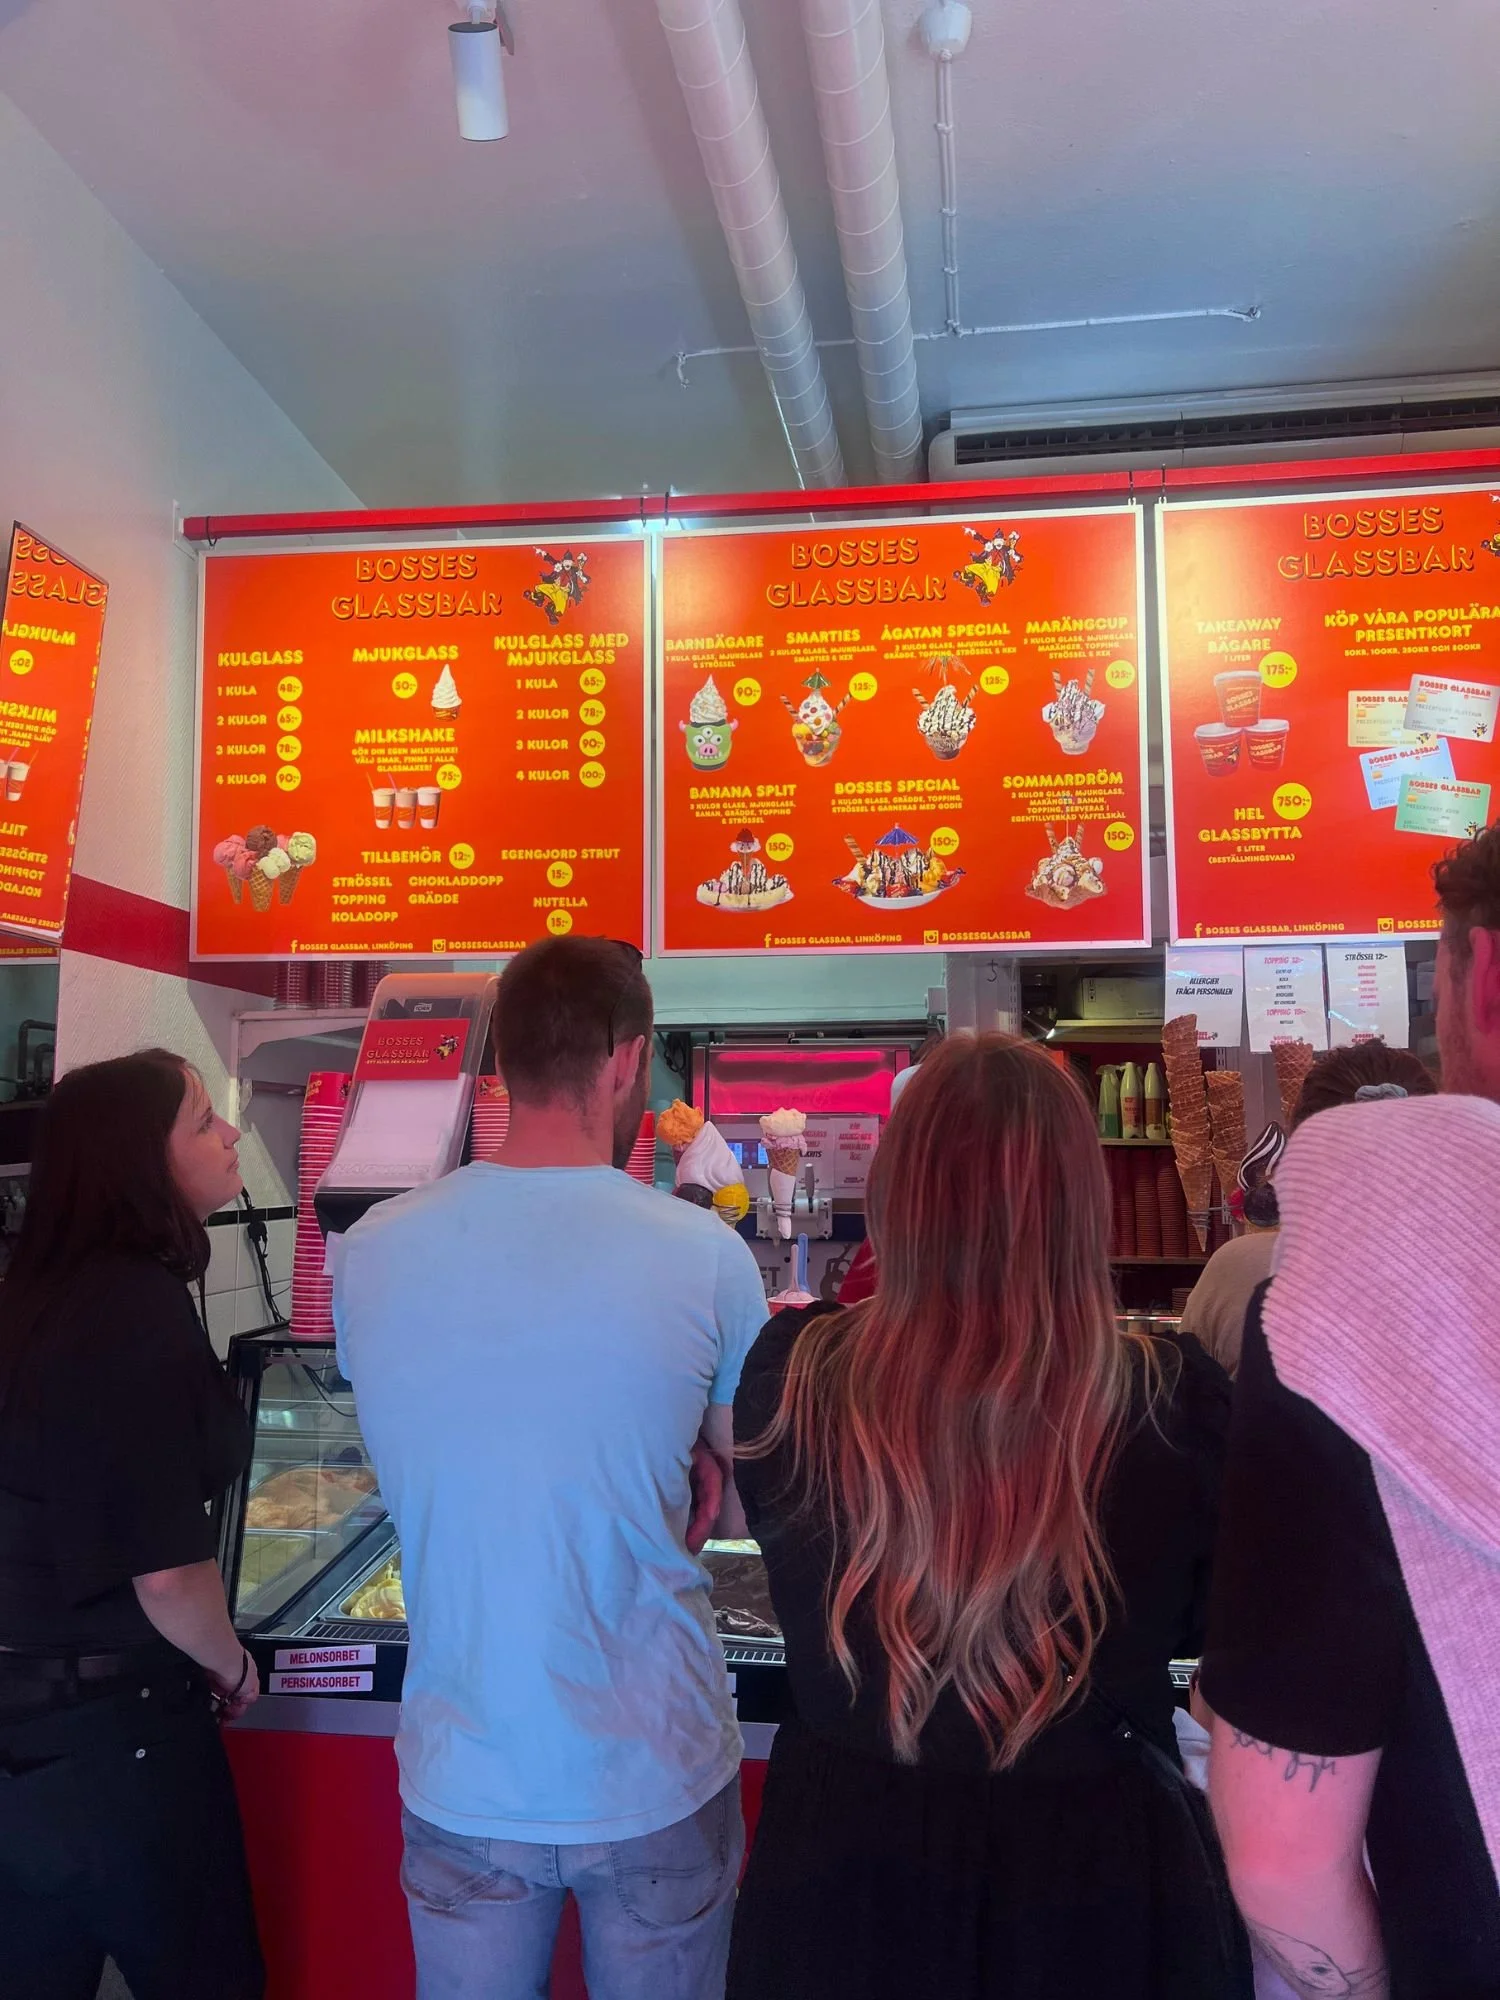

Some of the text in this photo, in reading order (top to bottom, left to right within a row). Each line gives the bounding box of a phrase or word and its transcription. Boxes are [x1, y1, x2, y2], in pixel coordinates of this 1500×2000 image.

[1303, 506, 1444, 539] BOSSES
[790, 537, 919, 569] BOSSES
[356, 553, 478, 582] BOSSES
[1277, 544, 1475, 580] GLASSBAR
[765, 575, 946, 608] GLASSBAR
[331, 589, 502, 621] GLASSBAR
[1324, 602, 1500, 627] KÖP VÅRA POPULÄRA
[880, 622, 1011, 640] ÅGATAN SPECIAL
[1026, 615, 1129, 634] MARÄNGCUP
[1196, 617, 1282, 633] TAKEAWAY
[786, 629, 861, 645] SMARTIES
[1355, 624, 1473, 642] PRESENTKORT
[494, 633, 630, 650] KULGLASS MED
[665, 633, 764, 651] BARNBÄGARE
[1207, 636, 1272, 654] BÄGARE
[218, 650, 304, 667] KULGLASS
[352, 645, 460, 663] MJUKGLASS
[506, 650, 616, 666] MJUKGLASS
[217, 685, 257, 696] 1 KULA
[517, 678, 558, 689] 1 KULA
[1418, 679, 1492, 697] BOSSES GLASSBAR
[1356, 695, 1385, 703] BOSSES
[216, 714, 267, 725] 2 KULOR
[516, 708, 569, 720] 2 KULOR
[354, 728, 456, 744] MILKSHAKE
[216, 743, 266, 755] 3 KULOR
[516, 739, 568, 750] 3 KULOR
[1368, 745, 1440, 765] BOSSES GLASSBAR
[216, 773, 267, 784] 4 KULOR
[516, 770, 570, 781] 4 KULOR
[1003, 768, 1124, 788] SOMMARDRÖM
[689, 784, 797, 799] BANANA SPLIT
[834, 778, 960, 795] BOSSES SPECIAL
[1408, 780, 1438, 790] BOSSES
[1439, 785, 1482, 796] GLASSBAR
[1234, 807, 1265, 821] HEL
[1198, 826, 1303, 842] GLASSBYTTA
[362, 845, 442, 865] TILLBEHÖR
[501, 848, 621, 860] EGENGJORD STRUT
[332, 873, 393, 888] STRÖSSEL
[408, 875, 504, 887] CHOKLADDOPP
[332, 893, 387, 906] TOPPING
[408, 890, 459, 904] GRÄDDE
[533, 897, 588, 907] NUTELLA
[332, 911, 399, 922] KOLADOPP
[1205, 926, 1241, 935] BOSSES
[1293, 921, 1345, 932] LINKÖPING
[774, 936, 808, 945] BOSSES
[855, 933, 902, 943] LINKÖPING
[941, 931, 1031, 941] BOSSESGLASSBAR
[300, 943, 328, 951] BOSSES
[371, 941, 413, 950] LINKÖPING
[449, 940, 526, 950] BOSSESGLASSBAR
[1344, 951, 1374, 960] STRÖSSEL
[1189, 977, 1219, 985] ALLERGIER
[1175, 986, 1233, 996] FRÅGA PERSONALEN
[377, 1036, 424, 1046] BOSSES
[366, 1049, 429, 1059] GLASSBAR
[290, 1650, 360, 1664] MELONSORBET
[281, 1676, 361, 1688] PERSIKASORBET
